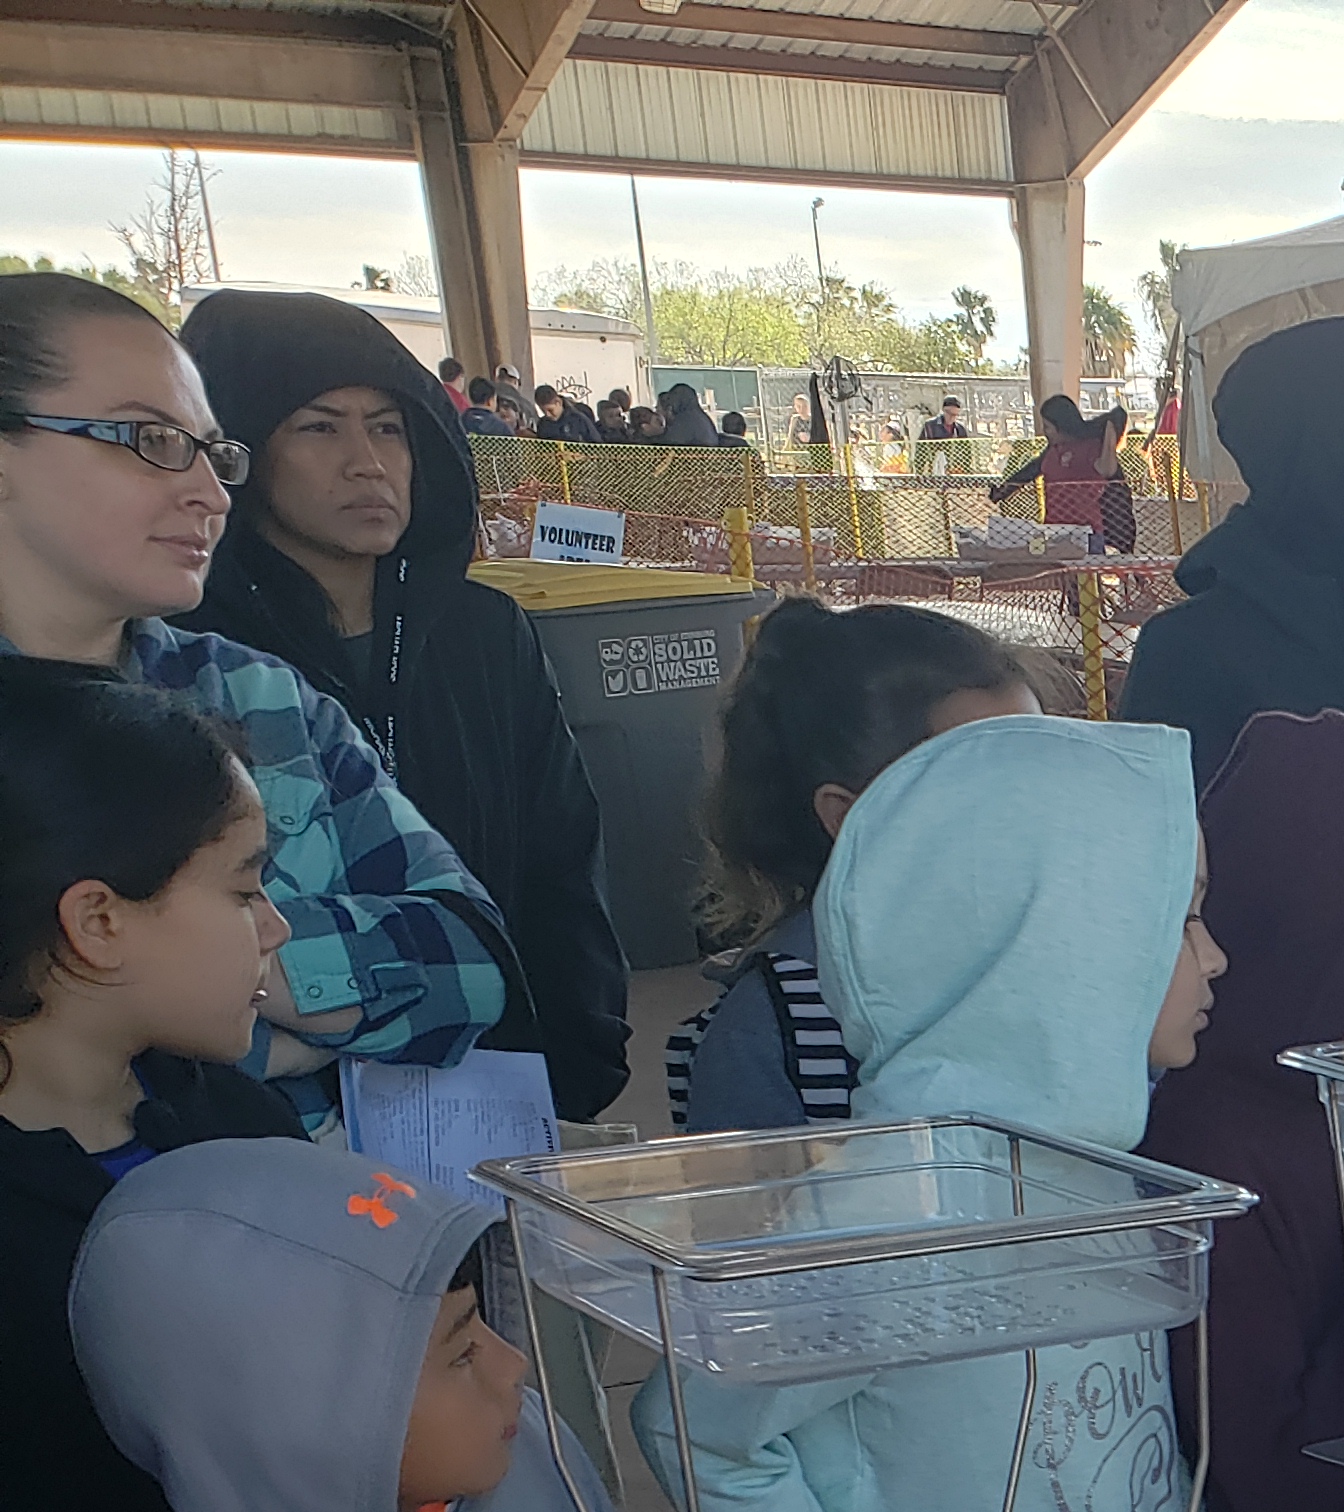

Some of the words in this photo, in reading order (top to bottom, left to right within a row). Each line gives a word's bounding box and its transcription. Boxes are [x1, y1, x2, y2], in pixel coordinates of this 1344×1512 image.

[539, 524, 616, 553] VOLUNTEER
[654, 638, 717, 662] SOLID
[656, 657, 720, 681] WASTE
[659, 675, 720, 691] MANAGEMENT
